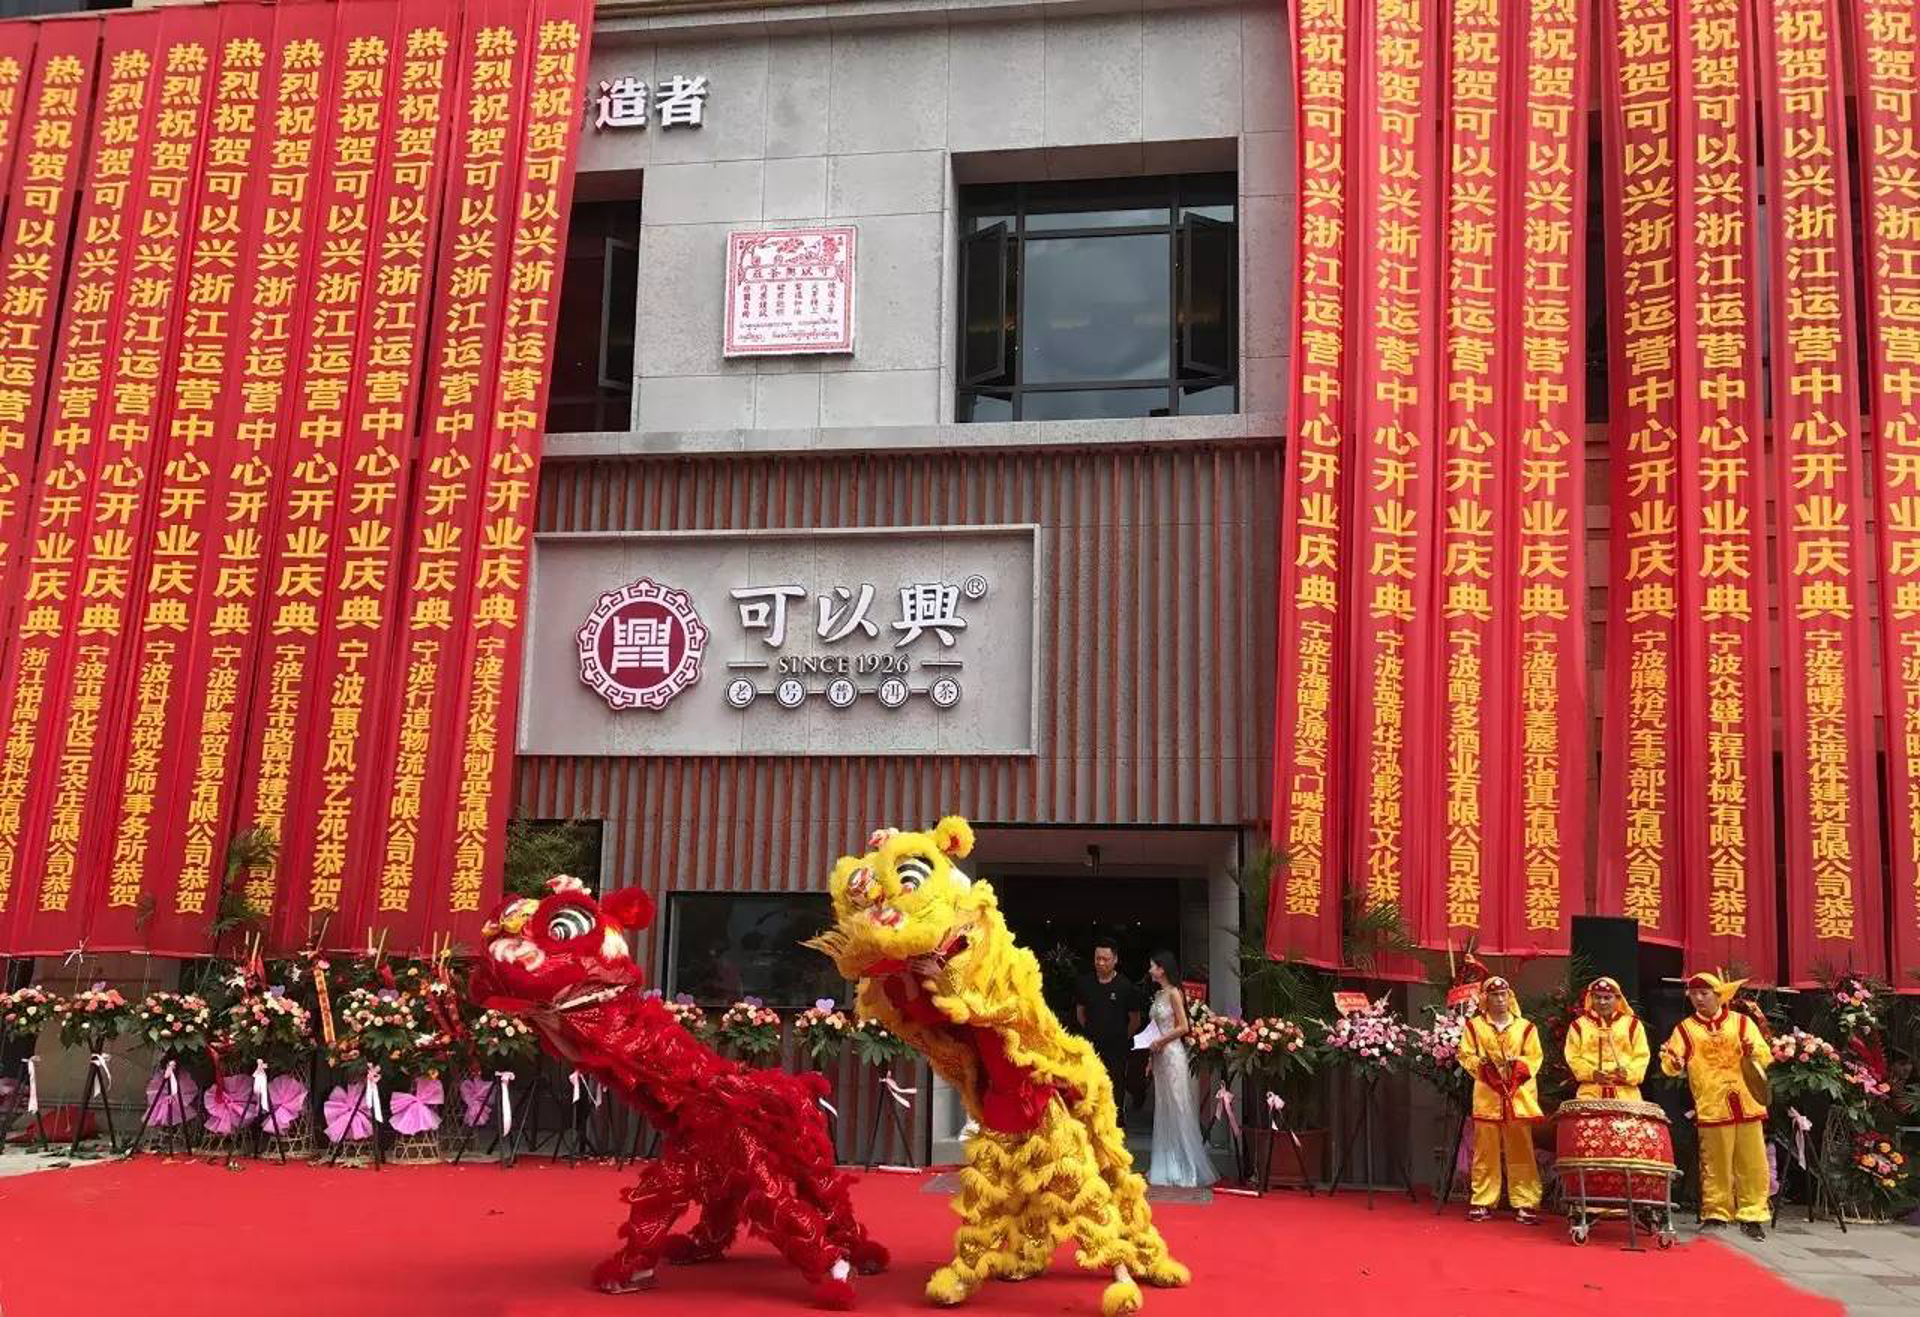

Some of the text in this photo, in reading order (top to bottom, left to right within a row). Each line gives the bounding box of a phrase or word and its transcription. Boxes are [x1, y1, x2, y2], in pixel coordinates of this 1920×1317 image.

[1775, 0, 1852, 620] 祝贺可以兴浙江运营中心开业庆典
[730, 583, 967, 648] 可以興
[778, 653, 909, 674] SINCE 1926
[1367, 631, 1402, 913] 宁波盐商华泓影视文化恭
